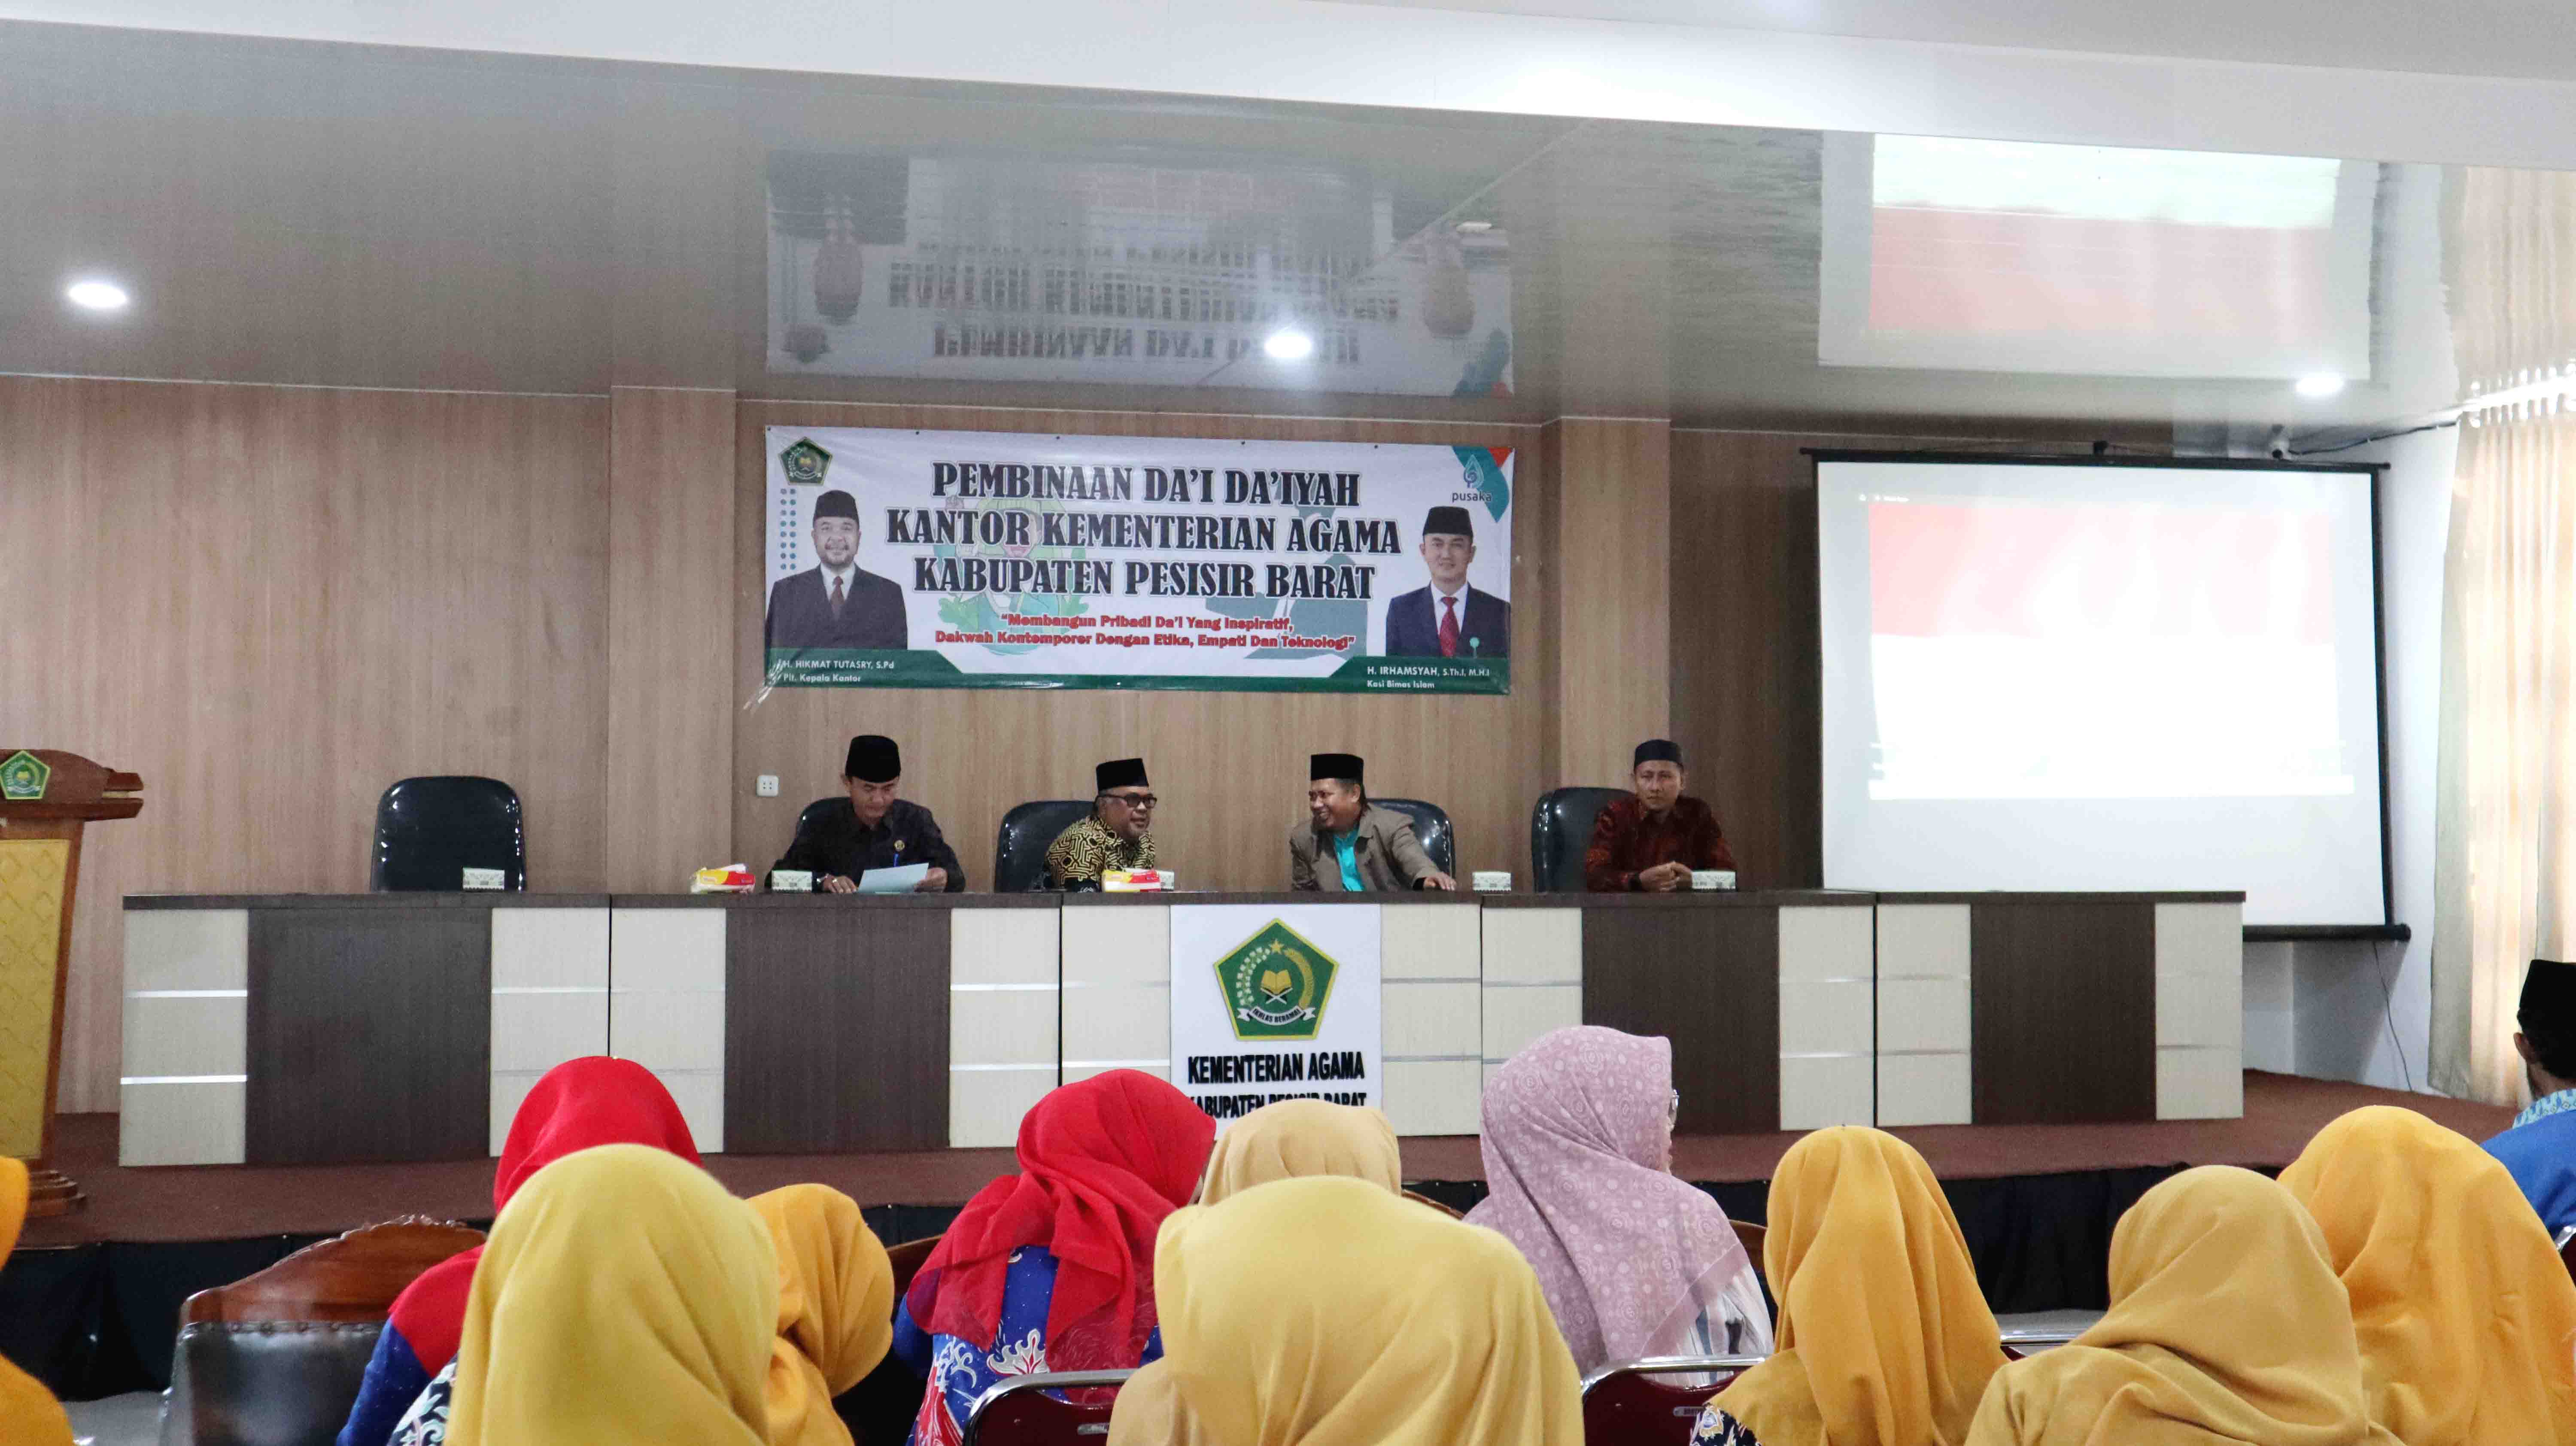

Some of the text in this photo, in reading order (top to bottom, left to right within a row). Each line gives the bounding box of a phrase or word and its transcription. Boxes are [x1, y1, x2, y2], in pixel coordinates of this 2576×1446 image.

[933, 462, 1360, 506] PEMBINAAN DA'I DA'IYAH
[1452, 491, 1492, 503] pusaka
[887, 509, 1402, 553] KANTOR KEMENTERIAN AGAMA
[914, 557, 1375, 599] KABUPATEN PESISIR BARAT
[1001, 614, 1096, 629] "Membangun
[1100, 615, 1151, 627] Pribadi
[1186, 617, 1221, 631] Yang
[1224, 617, 1293, 632] Inspiratif,
[936, 631, 1354, 650] Dakwah Kontemporer Dengan Etika, Empati Dan Teknologi"
[795, 660, 832, 668] HIKMAT
[833, 661, 873, 669] TUTASRY,
[876, 661, 895, 669] S.Pd
[1367, 666, 1376, 675] H.
[1380, 666, 1440, 677] IRHAMSYAH,
[800, 674, 829, 683] Kepala
[832, 674, 861, 682] Kantor
[1188, 1051, 1365, 1084] KEMENTERIAN AGAMA
[1191, 1094, 1264, 1119] ABUPATEN
